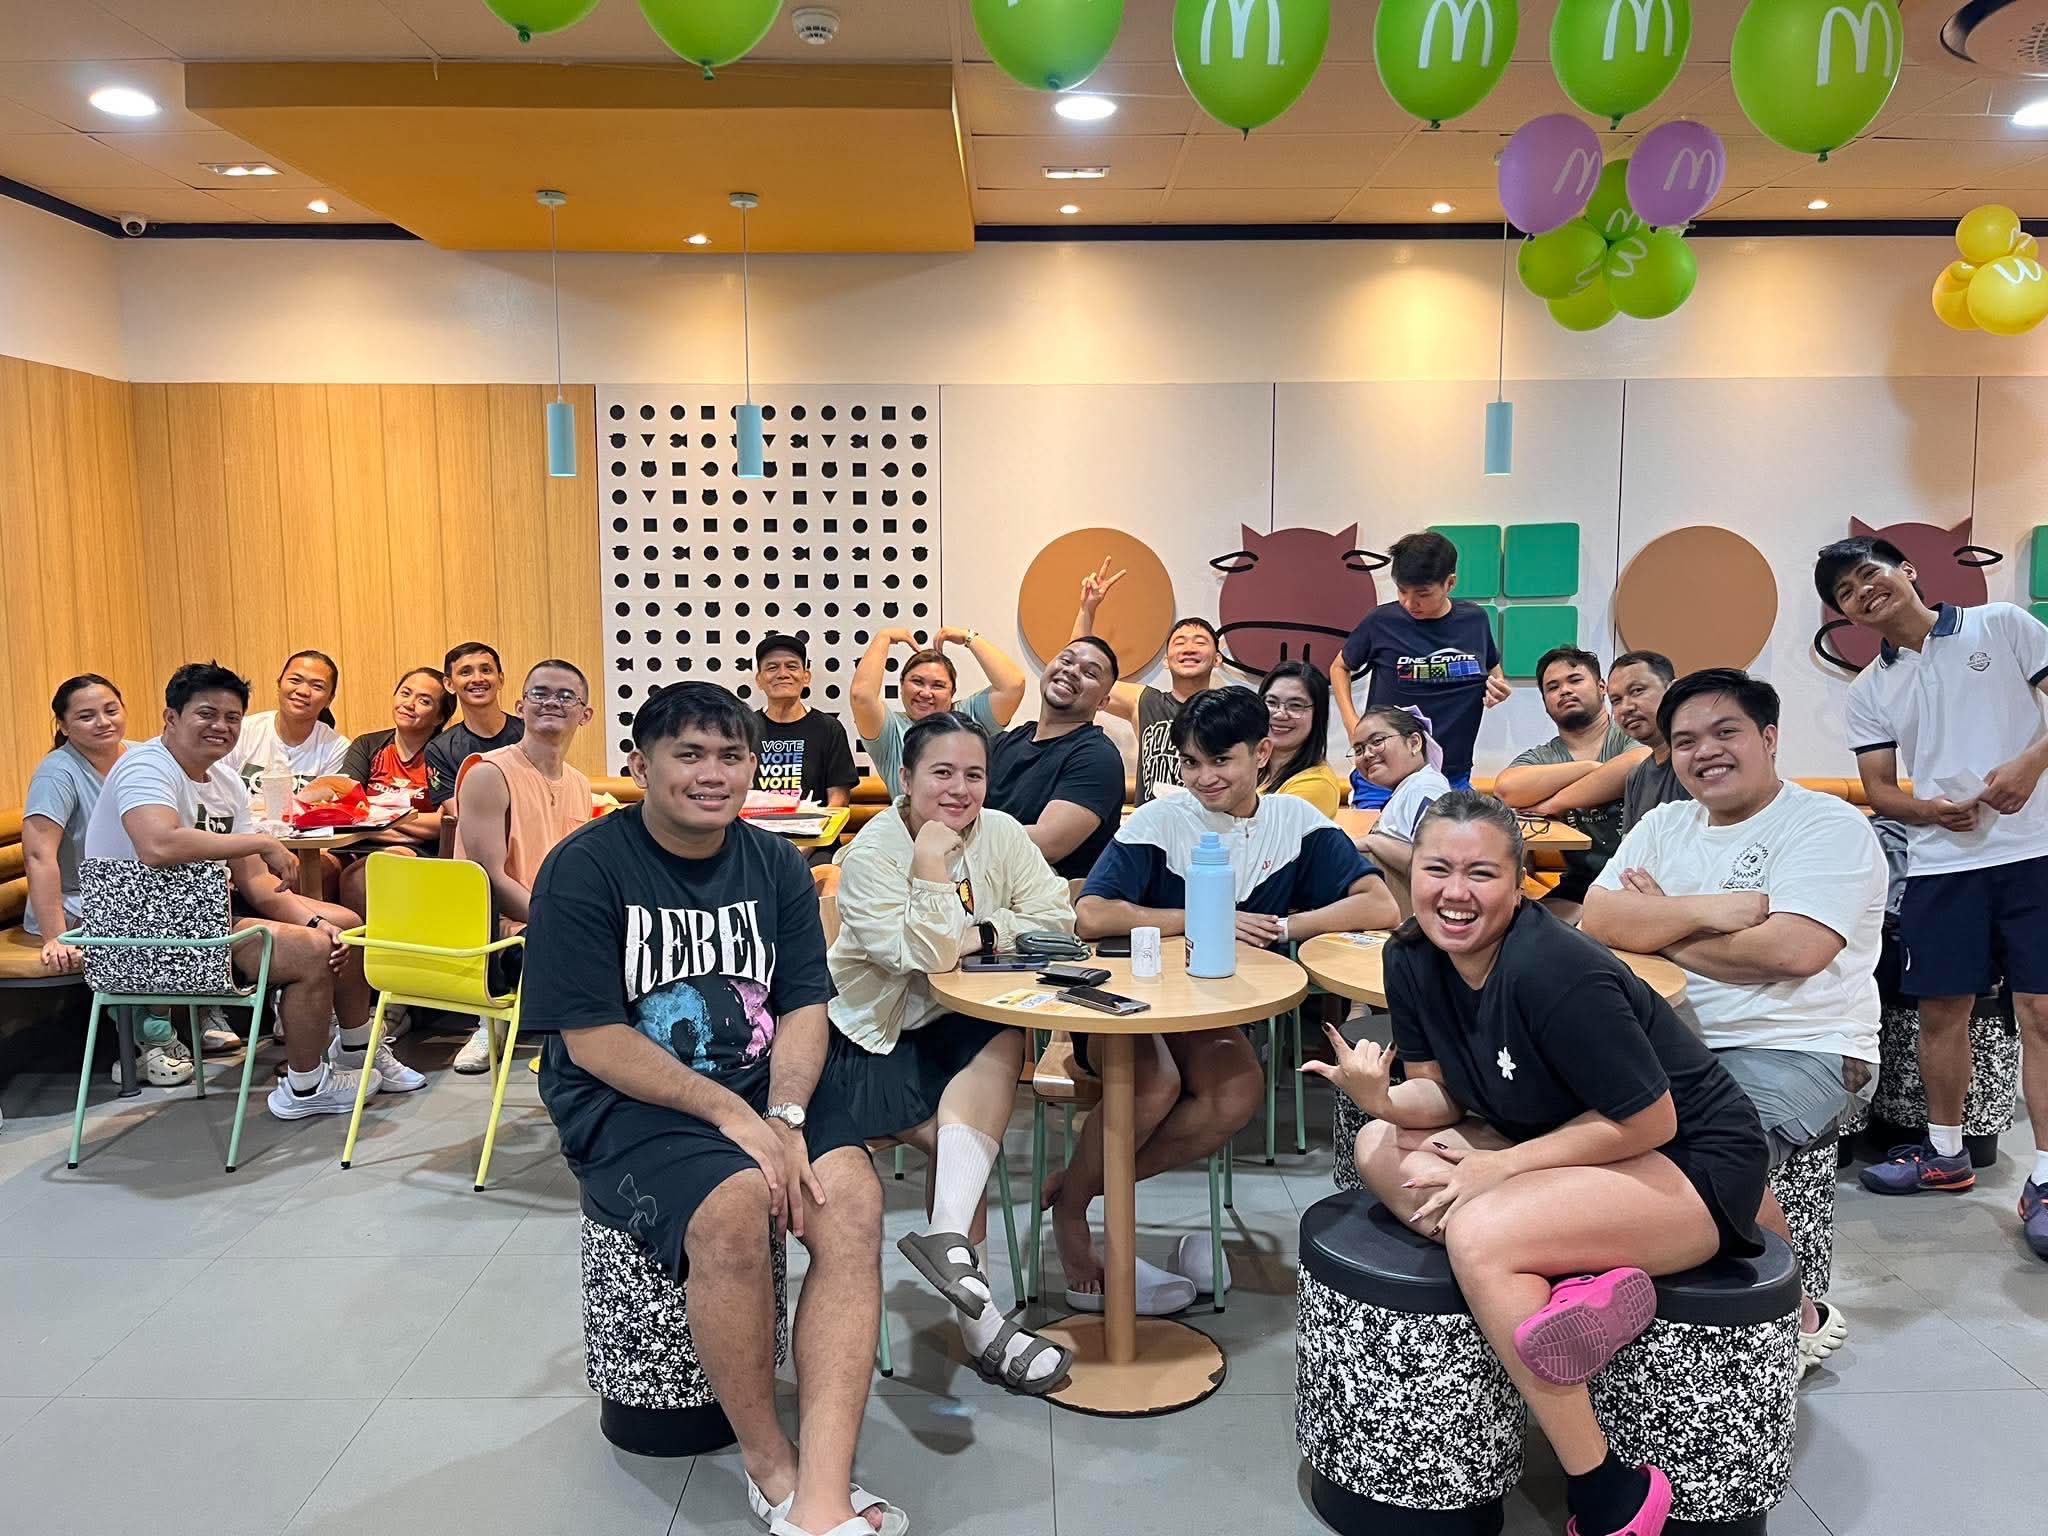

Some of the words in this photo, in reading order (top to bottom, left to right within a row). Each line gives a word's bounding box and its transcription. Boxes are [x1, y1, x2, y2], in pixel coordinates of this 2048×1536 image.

[1397, 656, 1427, 665] ONE
[1430, 654, 1476, 664] CAVITE
[761, 739, 805, 752] VOTE
[760, 752, 803, 764] VOTE
[759, 763, 803, 777] VOTE
[758, 776, 802, 790] VOTE
[624, 900, 777, 1002] REBEL
